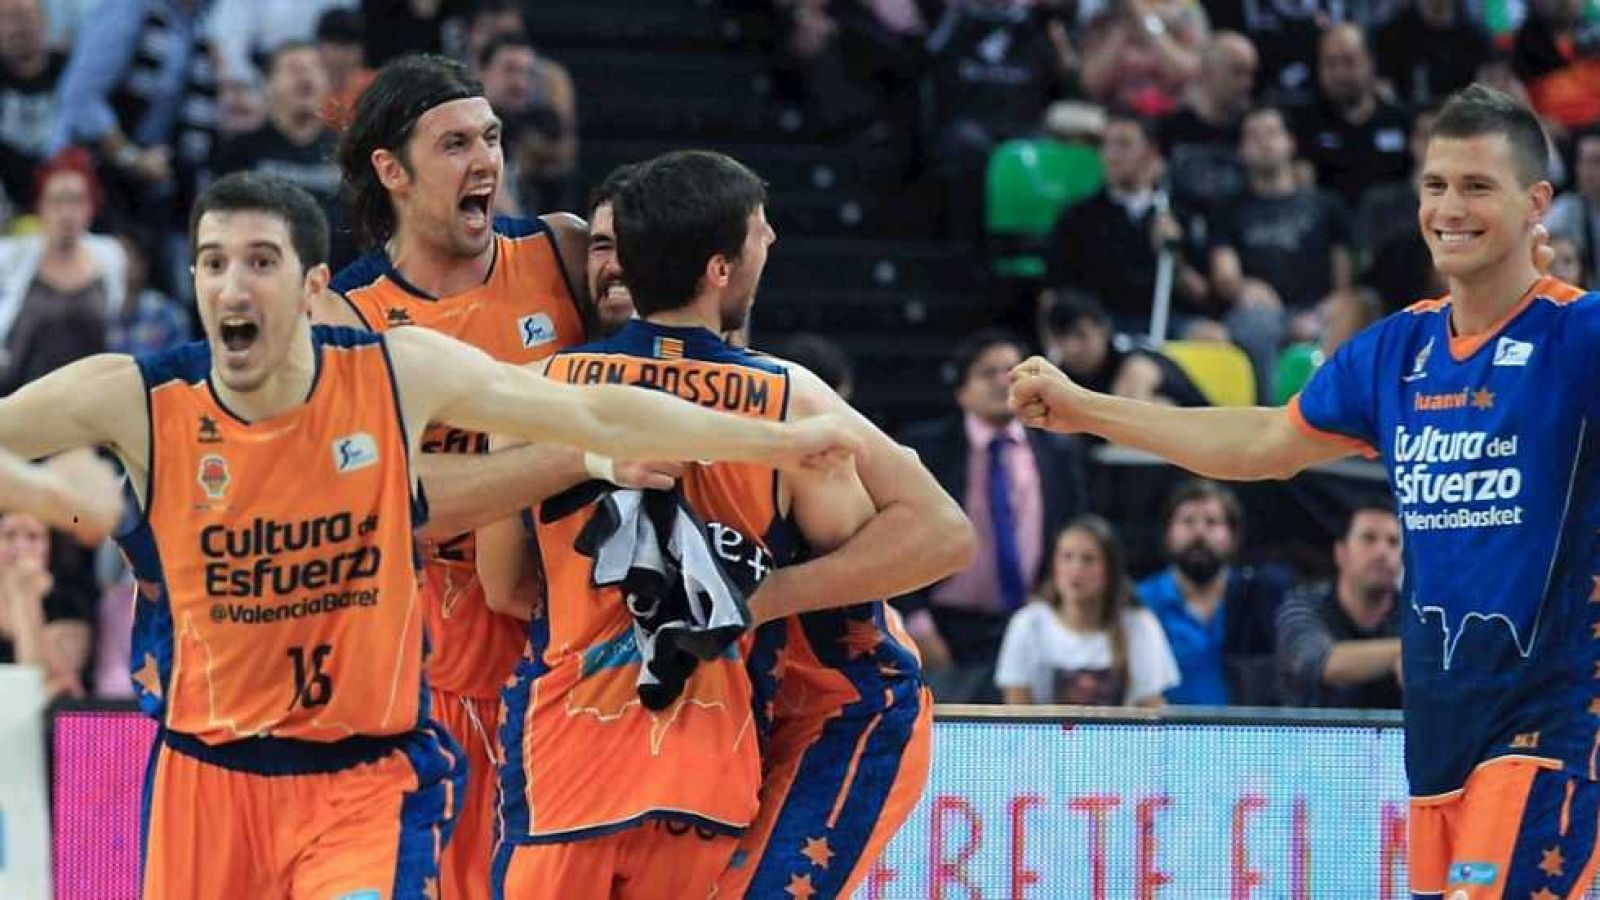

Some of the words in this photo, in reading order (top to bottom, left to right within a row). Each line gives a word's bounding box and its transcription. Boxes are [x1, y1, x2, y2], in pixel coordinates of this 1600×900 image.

[1395, 425, 1486, 463] Cultura
[1486, 436, 1517, 457] del
[1395, 463, 1521, 503] Esfuerzo
[201, 511, 351, 557] Cultura
[205, 545, 381, 597] Esfuerzo
[210, 588, 379, 624] @ValenciaBaet
